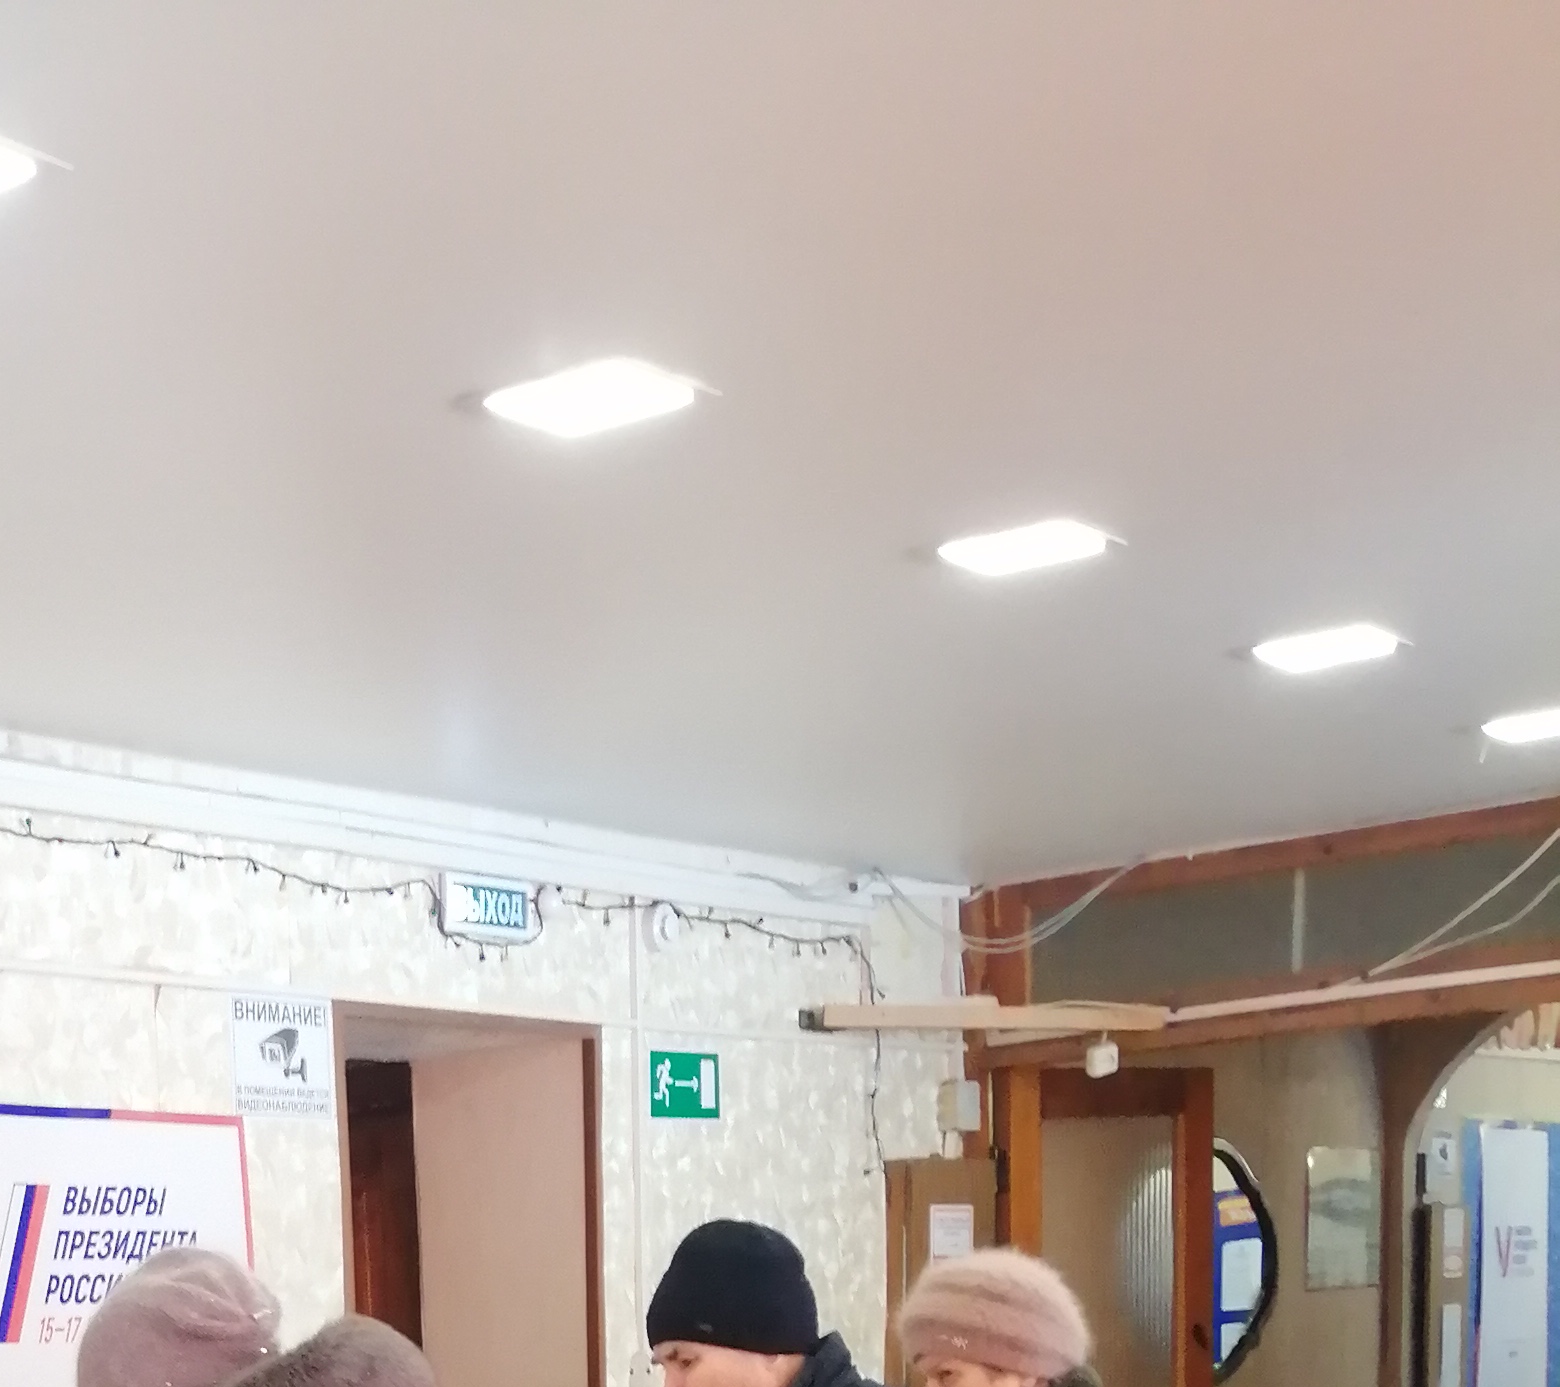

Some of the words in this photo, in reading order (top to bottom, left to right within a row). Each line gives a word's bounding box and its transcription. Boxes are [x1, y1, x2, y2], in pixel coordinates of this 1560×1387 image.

[234, 1001, 326, 1027] ВНИМАНИЕ!
[62, 1185, 168, 1216] ВЫБОРЫ
[45, 1273, 124, 1305] РОССИ
